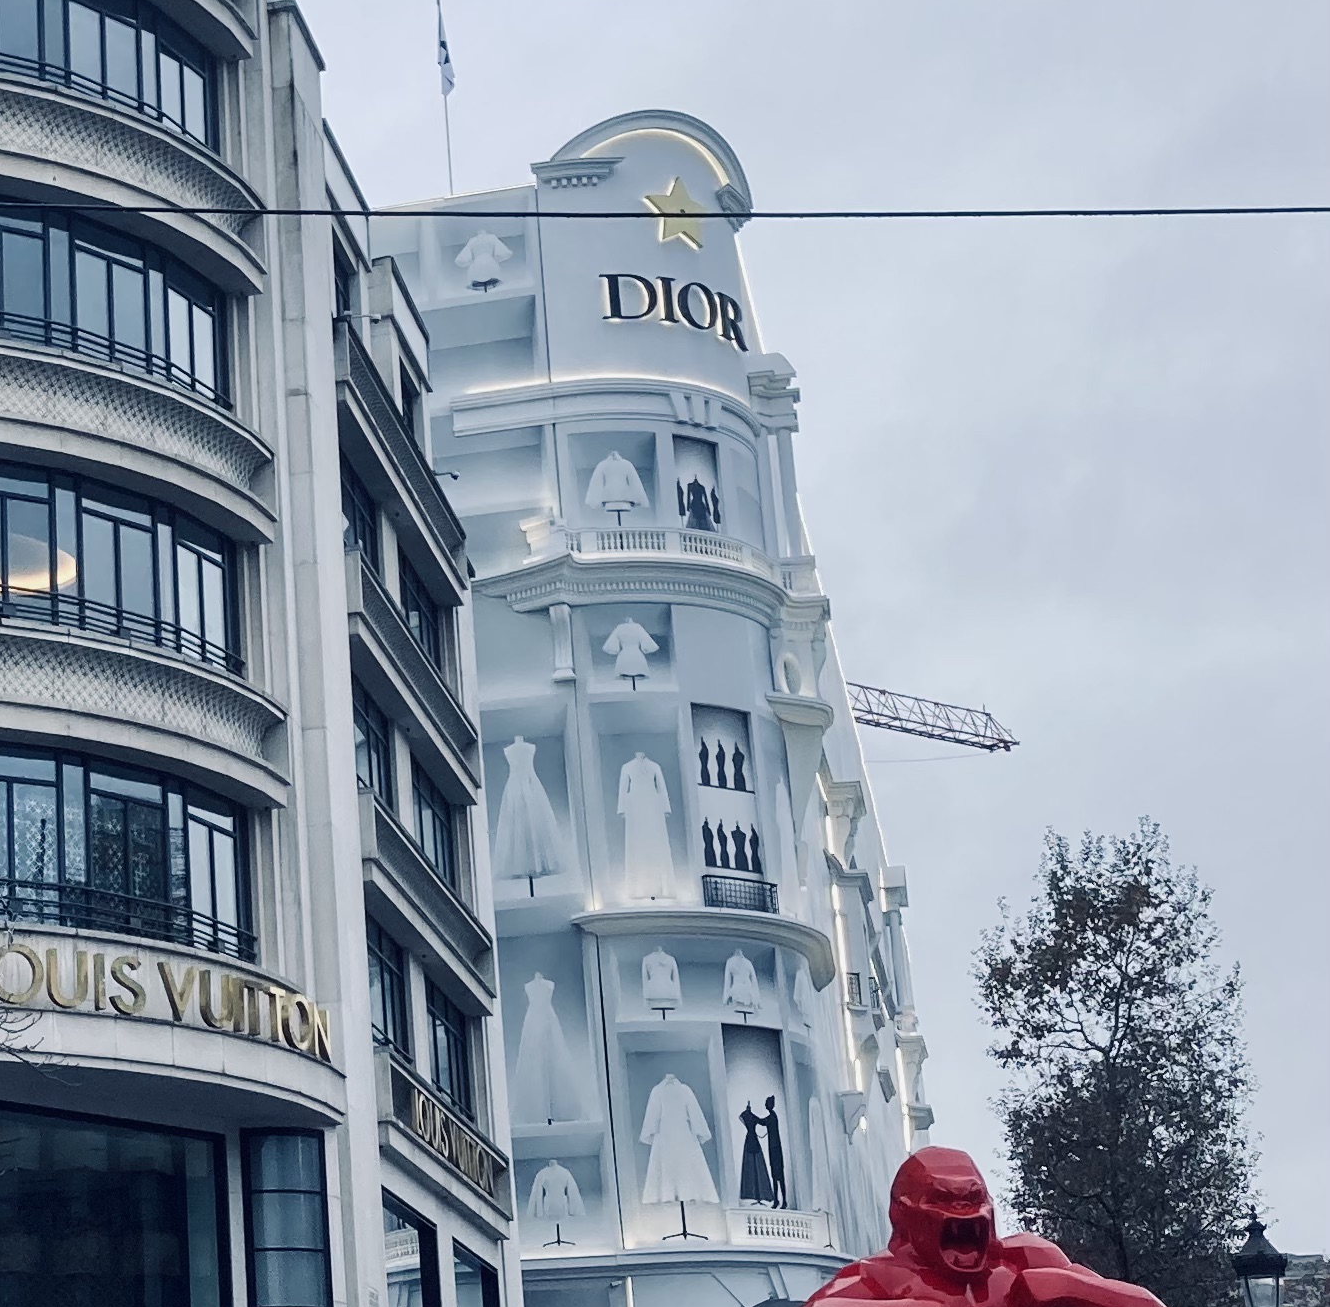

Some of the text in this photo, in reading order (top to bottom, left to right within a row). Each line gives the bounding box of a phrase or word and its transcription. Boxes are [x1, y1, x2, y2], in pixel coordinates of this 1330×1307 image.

[598, 273, 749, 353] DIOR
[157, 962, 332, 1063] VUITTON
[412, 1088, 449, 1159] LOUIS
